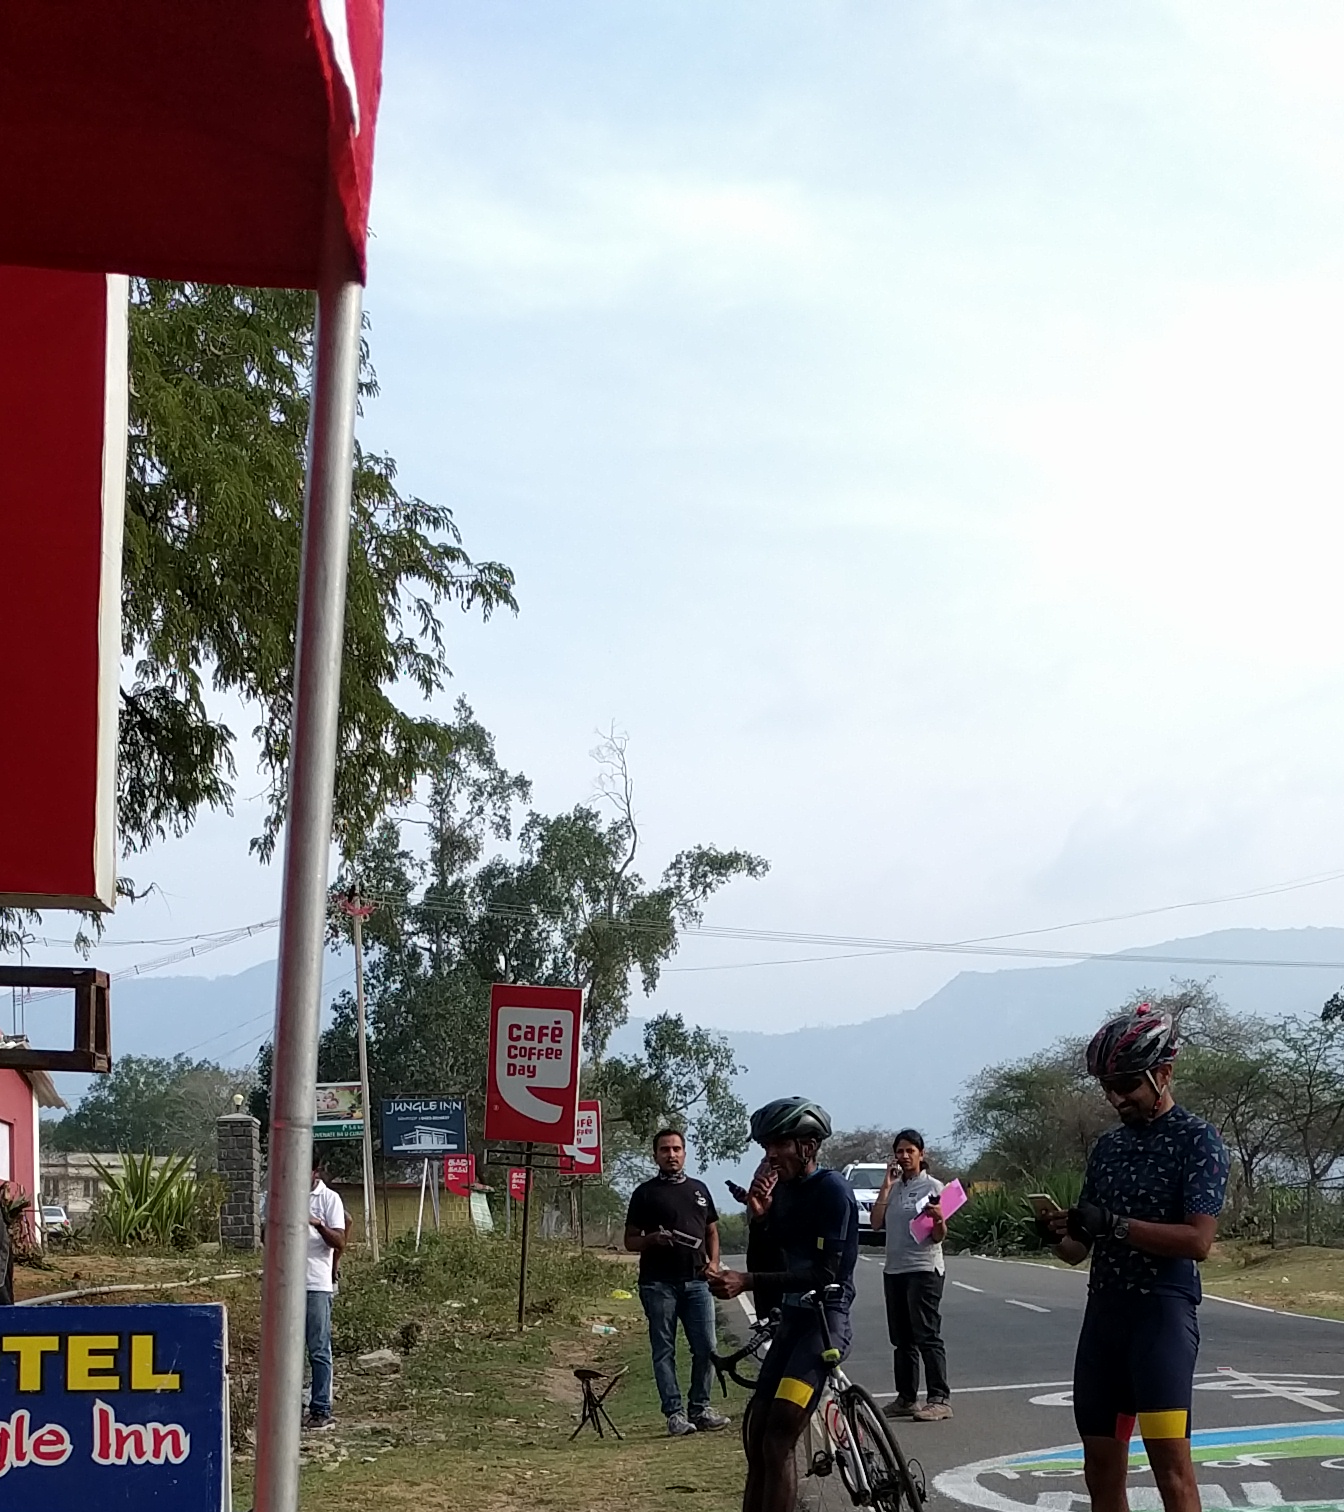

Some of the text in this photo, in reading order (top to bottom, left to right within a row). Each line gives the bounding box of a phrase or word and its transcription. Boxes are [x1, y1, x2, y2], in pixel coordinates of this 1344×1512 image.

[508, 1020, 563, 1044] Café
[507, 1044, 563, 1061] Coffee
[506, 1062, 537, 1079] Day
[385, 1101, 462, 1115] JUNGLE INN
[90, 1399, 190, 1466] Inn
